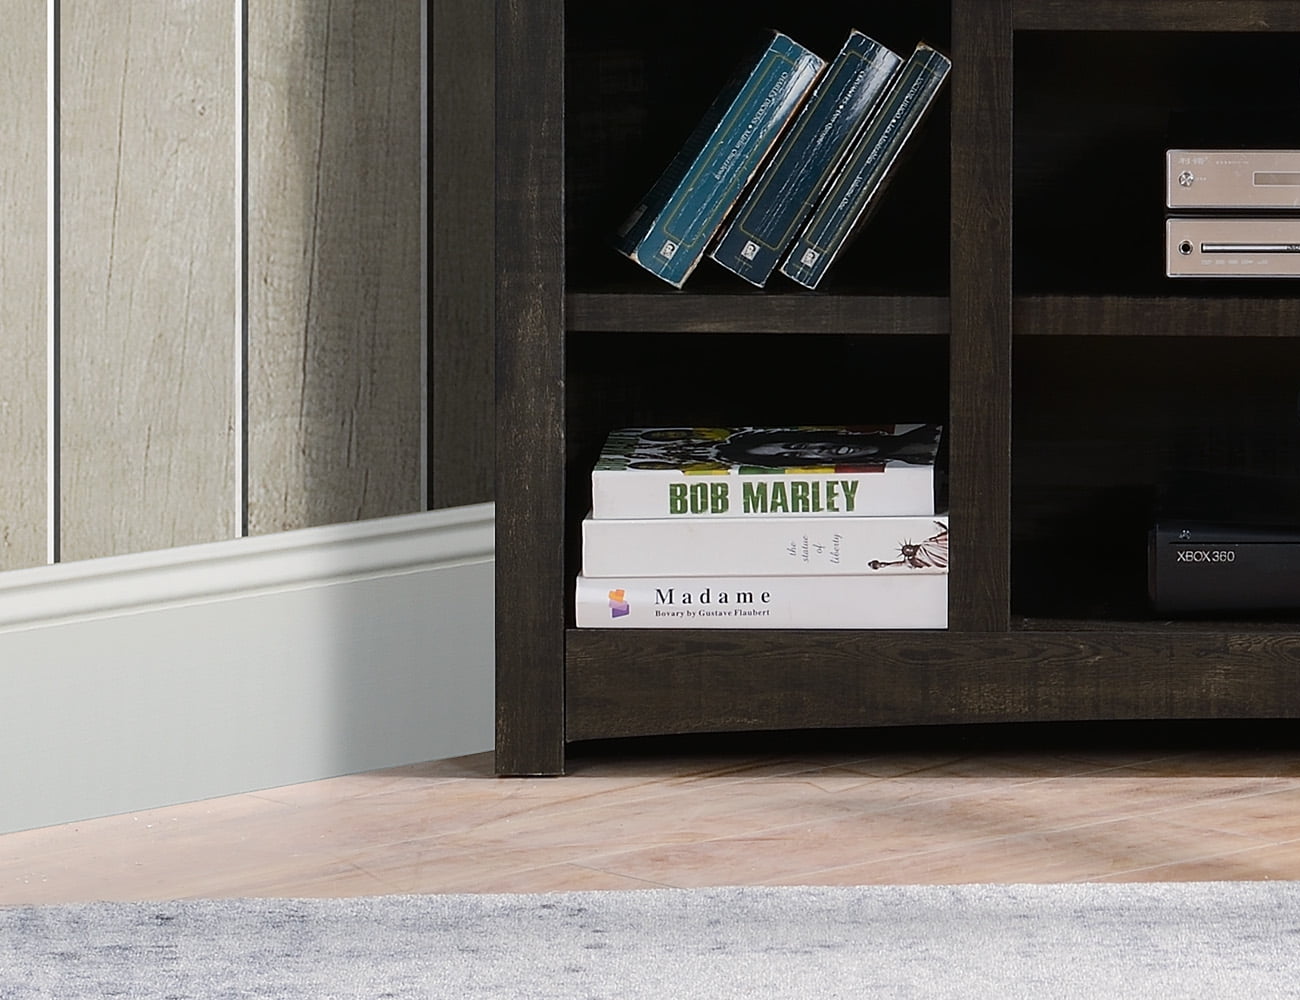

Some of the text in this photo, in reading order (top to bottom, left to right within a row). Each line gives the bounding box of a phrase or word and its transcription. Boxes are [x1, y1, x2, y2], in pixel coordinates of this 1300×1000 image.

[751, 97, 772, 125] DICKENS
[669, 480, 859, 515] BOB MARLEY
[786, 541, 796, 556] the
[801, 535, 809, 562] statue
[812, 543, 826, 554] of
[829, 534, 843, 564] liberty
[1177, 550, 1235, 562] XBOX 360
[655, 588, 770, 605] Madame
[655, 608, 770, 618] Bovary by Gustave Flaubert
